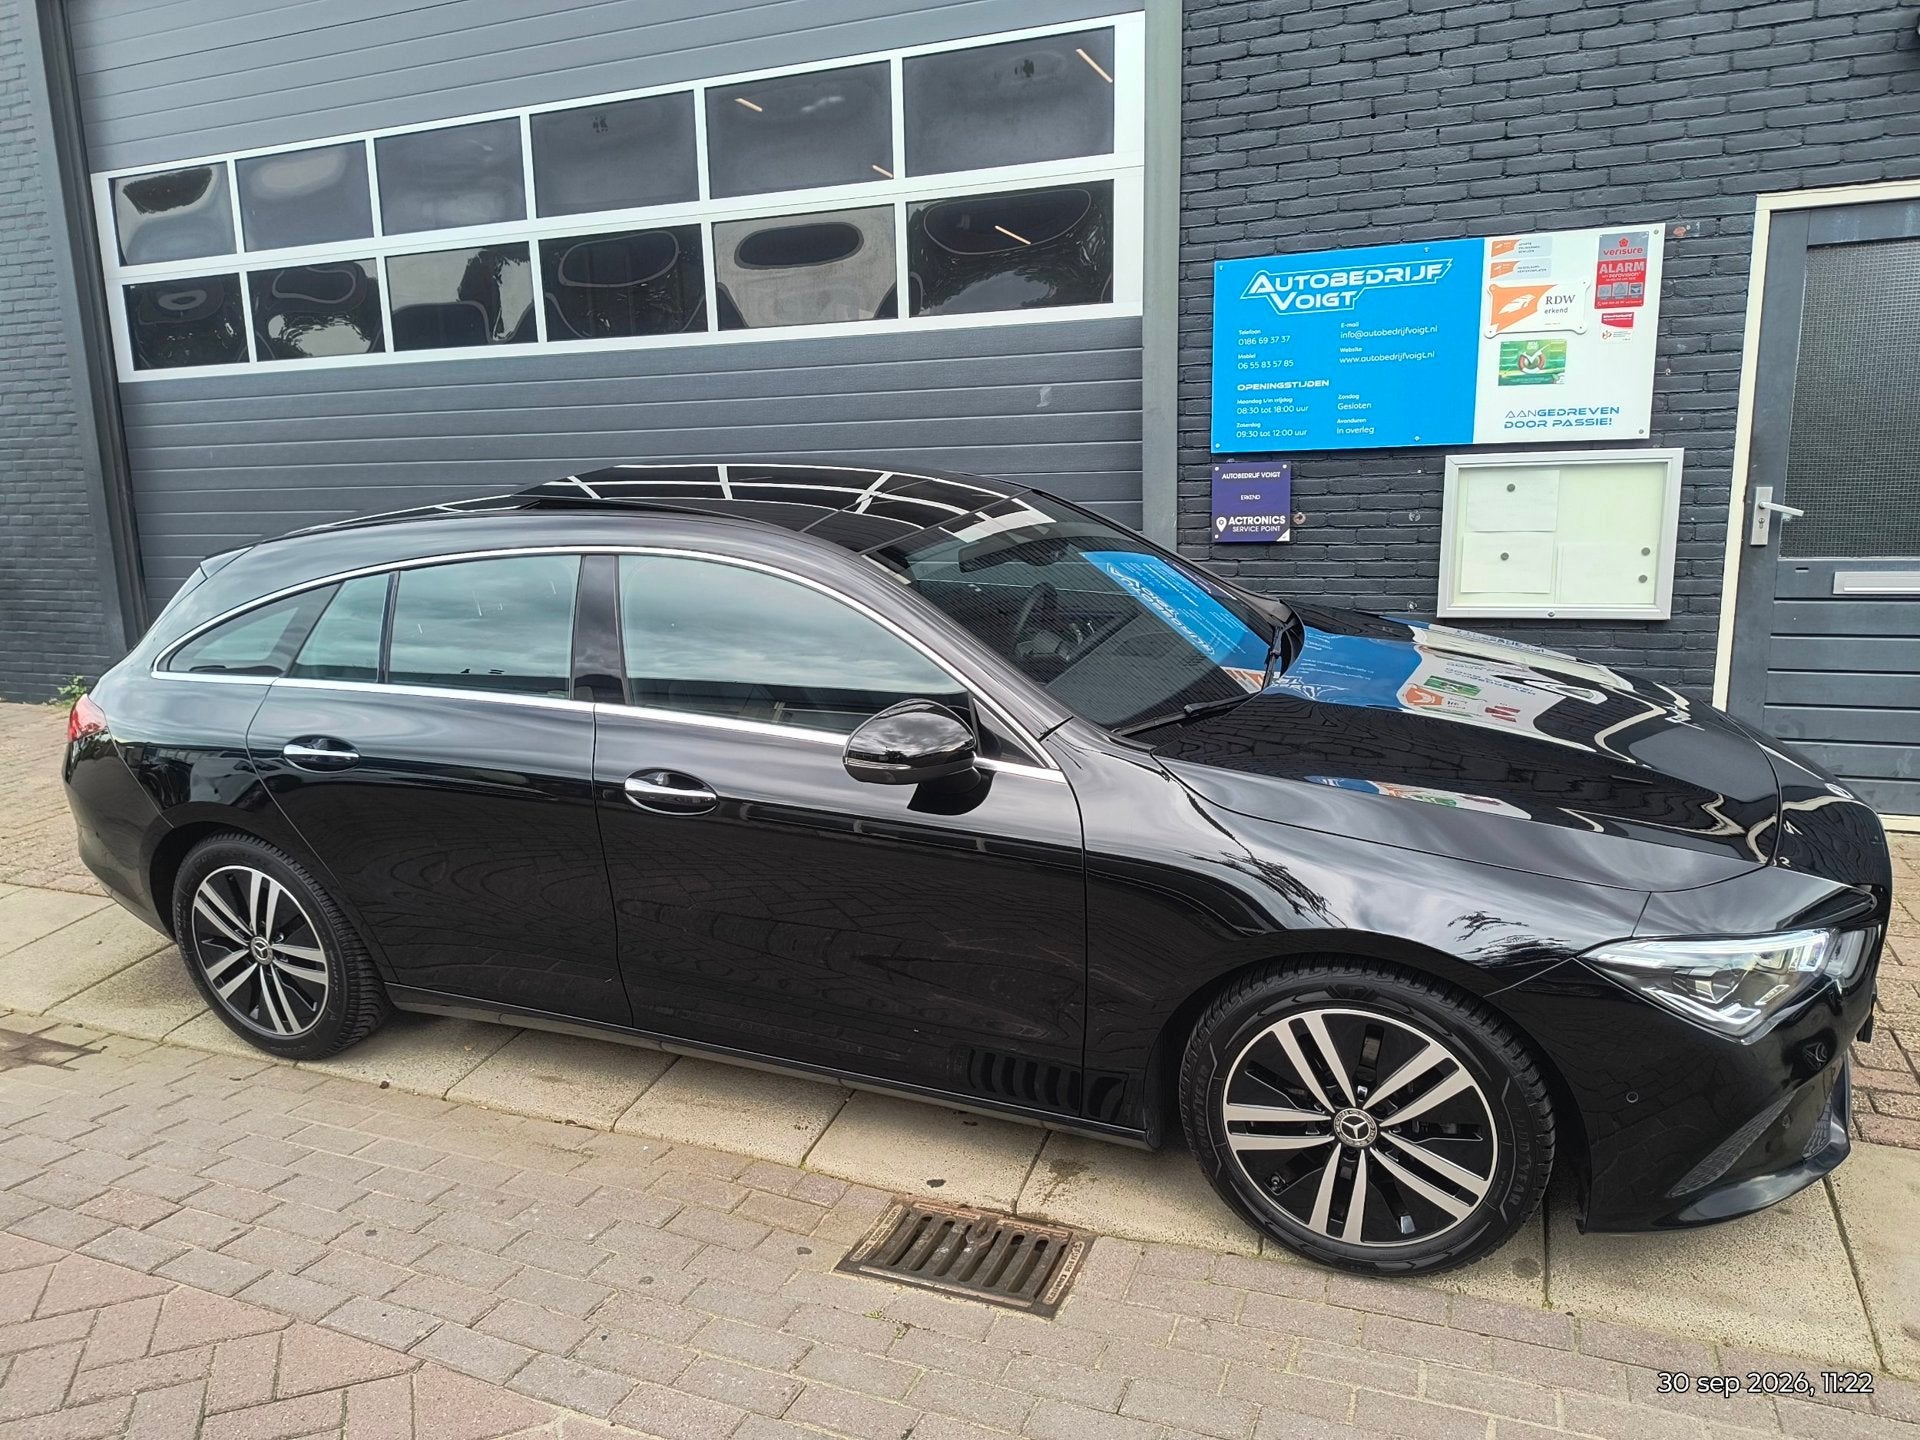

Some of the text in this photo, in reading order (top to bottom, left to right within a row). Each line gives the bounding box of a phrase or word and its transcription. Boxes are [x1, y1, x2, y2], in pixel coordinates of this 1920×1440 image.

[1603, 247, 1643, 256] verisure
[1600, 261, 1645, 274] ALARM
[1248, 264, 1444, 294] AUTOBEDRIJF
[1270, 290, 1357, 311] VOIGT
[1545, 294, 1576, 305] RDW
[1340, 325, 1438, 339] info@autobedrijfvoigt.nl
[1238, 335, 1291, 346] 0186 69 37 37
[1339, 351, 1435, 363] www.autobedrijfvoigt.nl
[1237, 359, 1294, 370] 06 55 83 57 85
[1237, 379, 1330, 391] OPENINGSTIJDEN
[1236, 406, 1259, 414] 08:30
[1273, 405, 1295, 413] 18:00
[1337, 402, 1372, 410] Gesloten
[1505, 406, 1620, 419] AANGEDREVEN
[1504, 417, 1612, 429] DOOR PASSIE!
[1236, 430, 1258, 438] 09:30
[1272, 428, 1293, 437] 12:00
[1345, 426, 1375, 435] overleg
[1228, 515, 1286, 526] ACTRONICS
[1232, 525, 1259, 533] SERVICE
